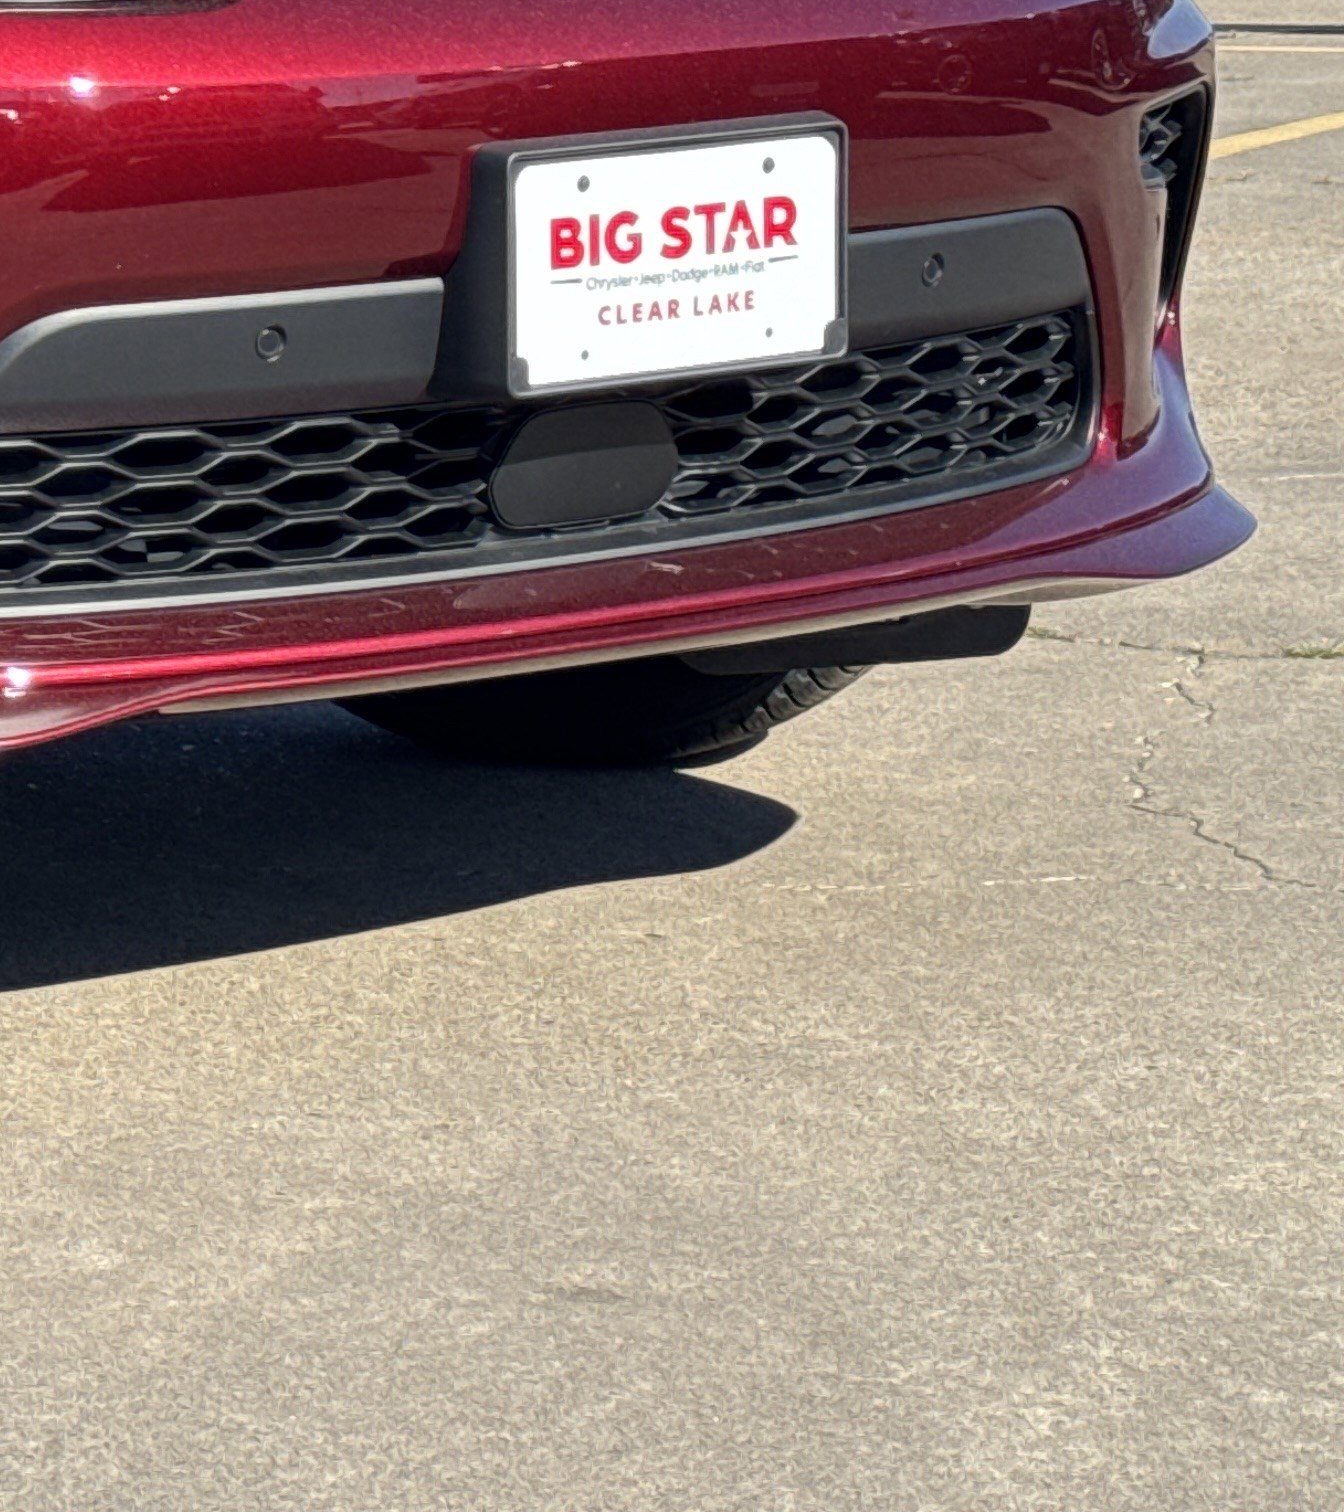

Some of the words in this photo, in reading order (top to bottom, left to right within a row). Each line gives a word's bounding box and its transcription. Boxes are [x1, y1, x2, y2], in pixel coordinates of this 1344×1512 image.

[550, 210, 643, 271] BIG
[659, 195, 799, 259] STAR
[585, 275, 633, 291] Chrysler
[639, 273, 665, 286] Jeep
[671, 268, 709, 283] Dodge
[713, 263, 739, 277] RAM
[597, 298, 681, 326] CLEAR
[693, 290, 755, 317] LAKE
